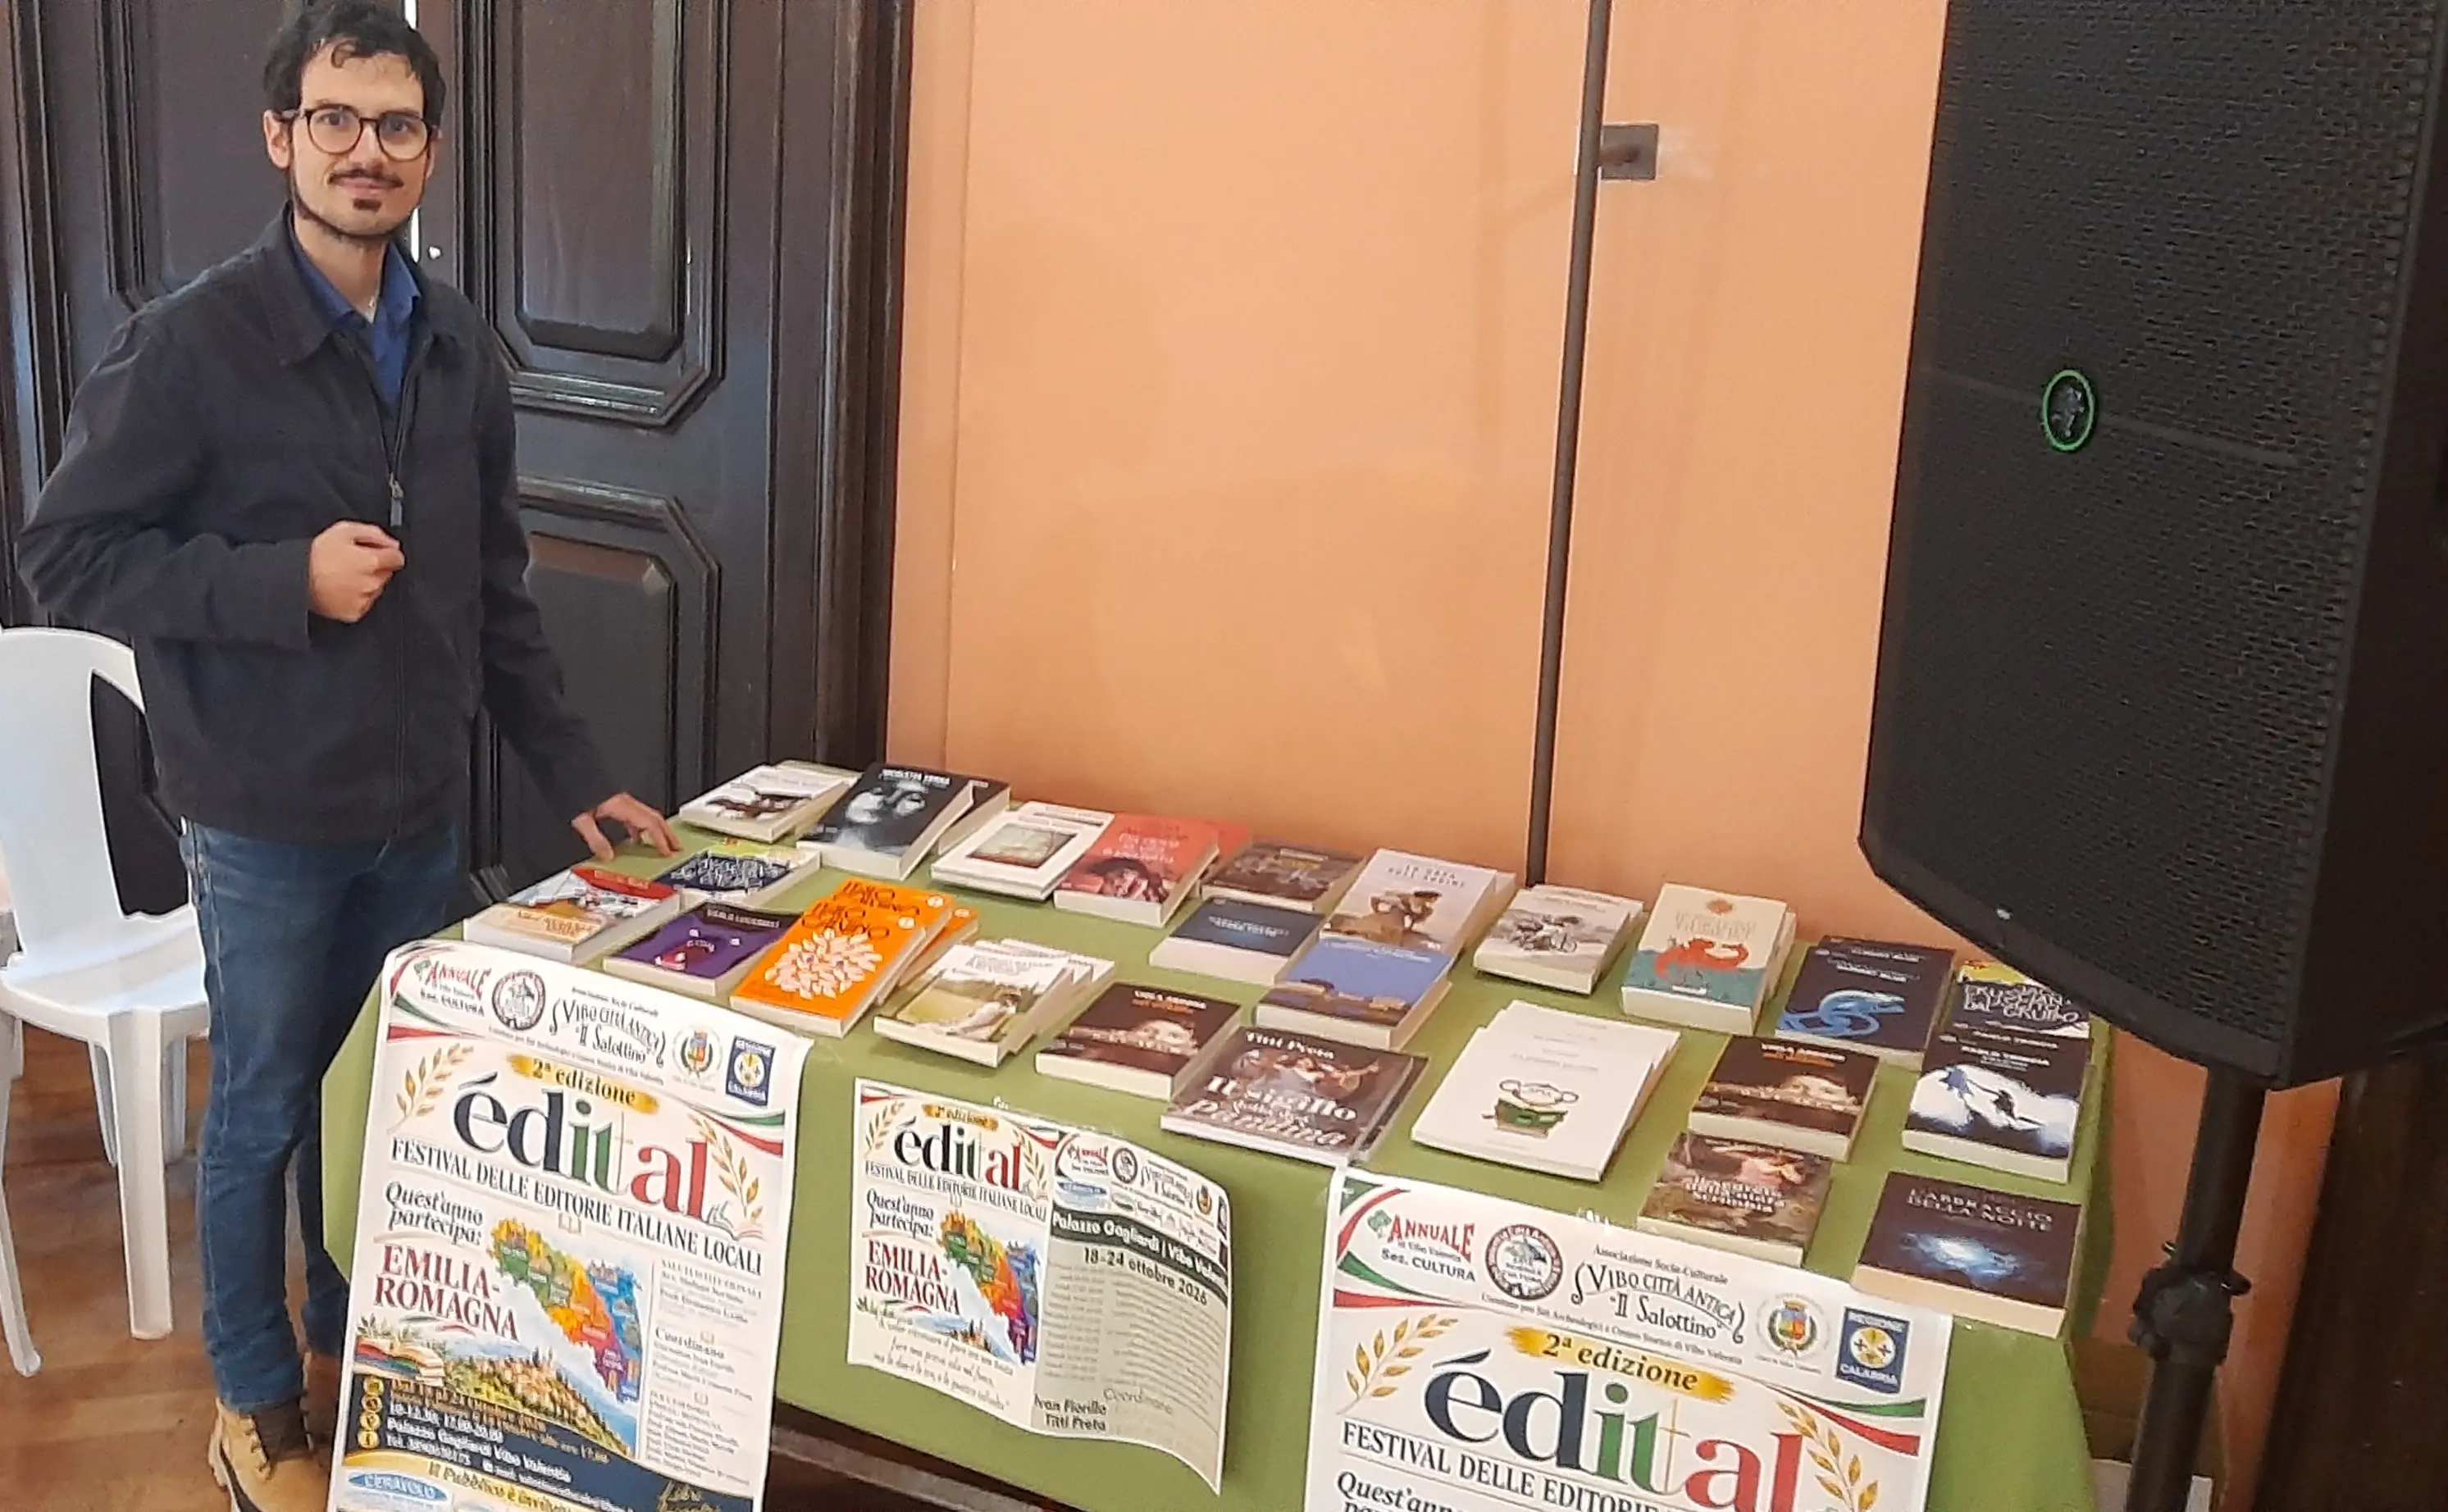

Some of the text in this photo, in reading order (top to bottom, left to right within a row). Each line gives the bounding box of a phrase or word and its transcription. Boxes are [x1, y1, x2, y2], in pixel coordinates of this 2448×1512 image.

[554, 1068, 636, 1108] edizione
[385, 1180, 484, 1227] Quest'anno
[388, 1208, 482, 1246] partecipa:
[391, 1136, 763, 1277] FESTIVAL DELLE EDITORIE ITALIANE LOCALI
[868, 1239, 948, 1282] EMILIA-
[1387, 1214, 1476, 1264] ANNUALE
[382, 1245, 501, 1300] EMILIA-
[864, 1264, 961, 1316] ROMAGNA
[1128, 1258, 1176, 1288] ottobre
[1411, 1255, 1477, 1282] CULTURA
[373, 1275, 520, 1343] ROMAGNA
[1587, 1264, 1640, 1291] VIBO
[1683, 1283, 1737, 1327] ANTICA
[1576, 1345, 1699, 1393] edizione
[1343, 1420, 1659, 1512] FESTIVAL DELLE EDITOR
